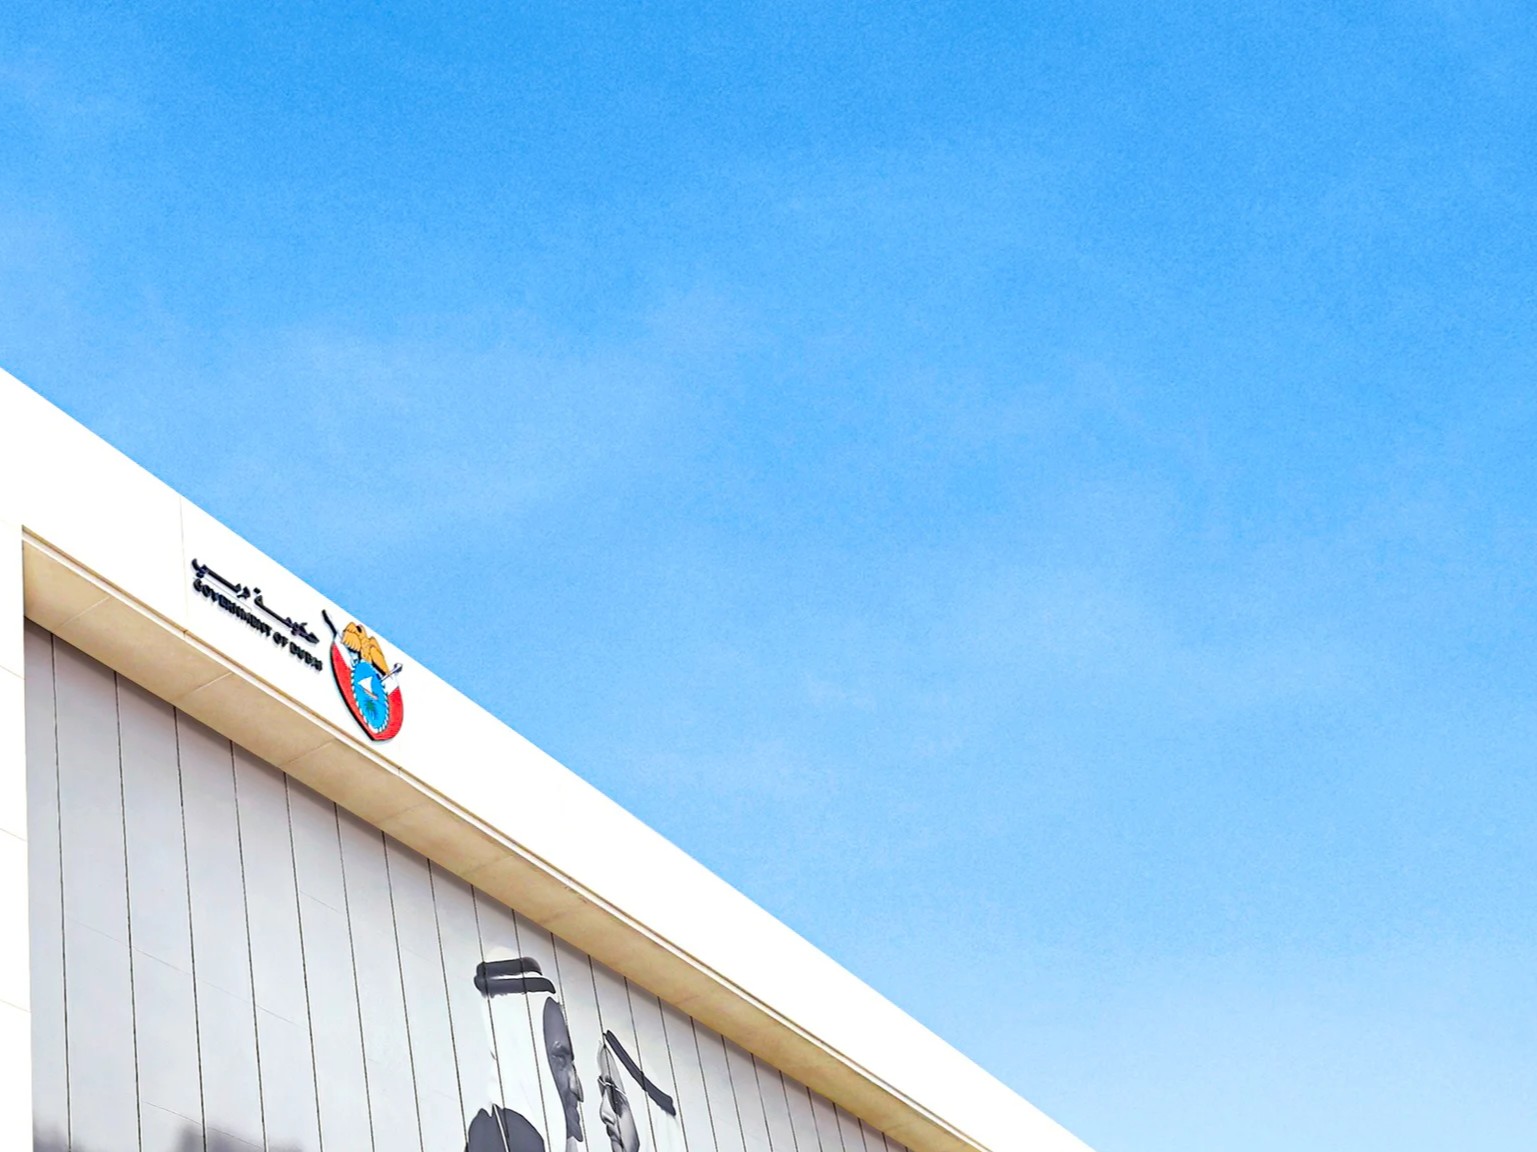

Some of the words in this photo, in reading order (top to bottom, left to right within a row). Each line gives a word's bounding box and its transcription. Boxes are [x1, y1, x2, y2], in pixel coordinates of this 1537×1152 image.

[191, 558, 251, 599] دبي
[193, 578, 272, 637] GOVERNMENT
[273, 631, 288, 647] OF
[289, 641, 323, 671] DUBAI
